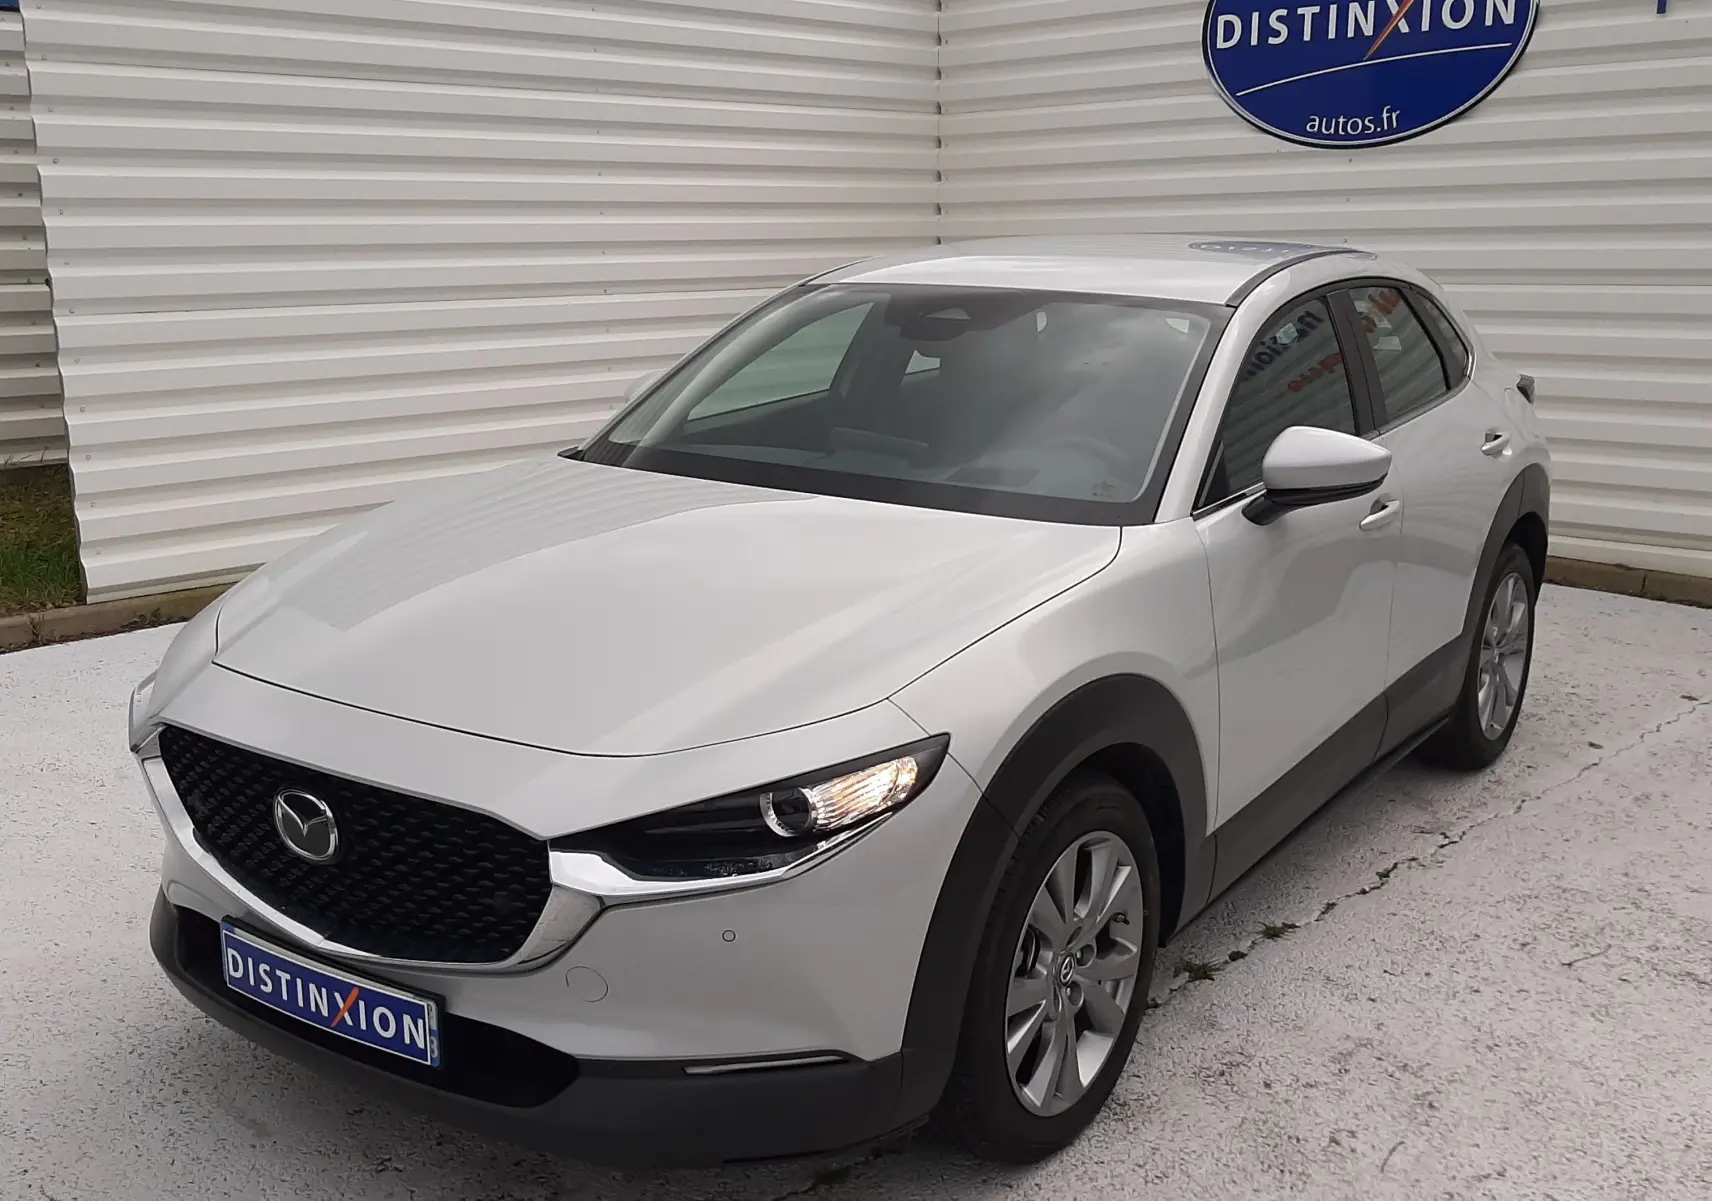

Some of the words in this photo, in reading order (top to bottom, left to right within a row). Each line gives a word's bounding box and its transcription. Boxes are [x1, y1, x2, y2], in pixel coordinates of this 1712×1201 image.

[1216, 0, 1516, 51] DISTINXION
[1306, 105, 1400, 135] autos.fr
[227, 947, 426, 1050] DISTINXION
